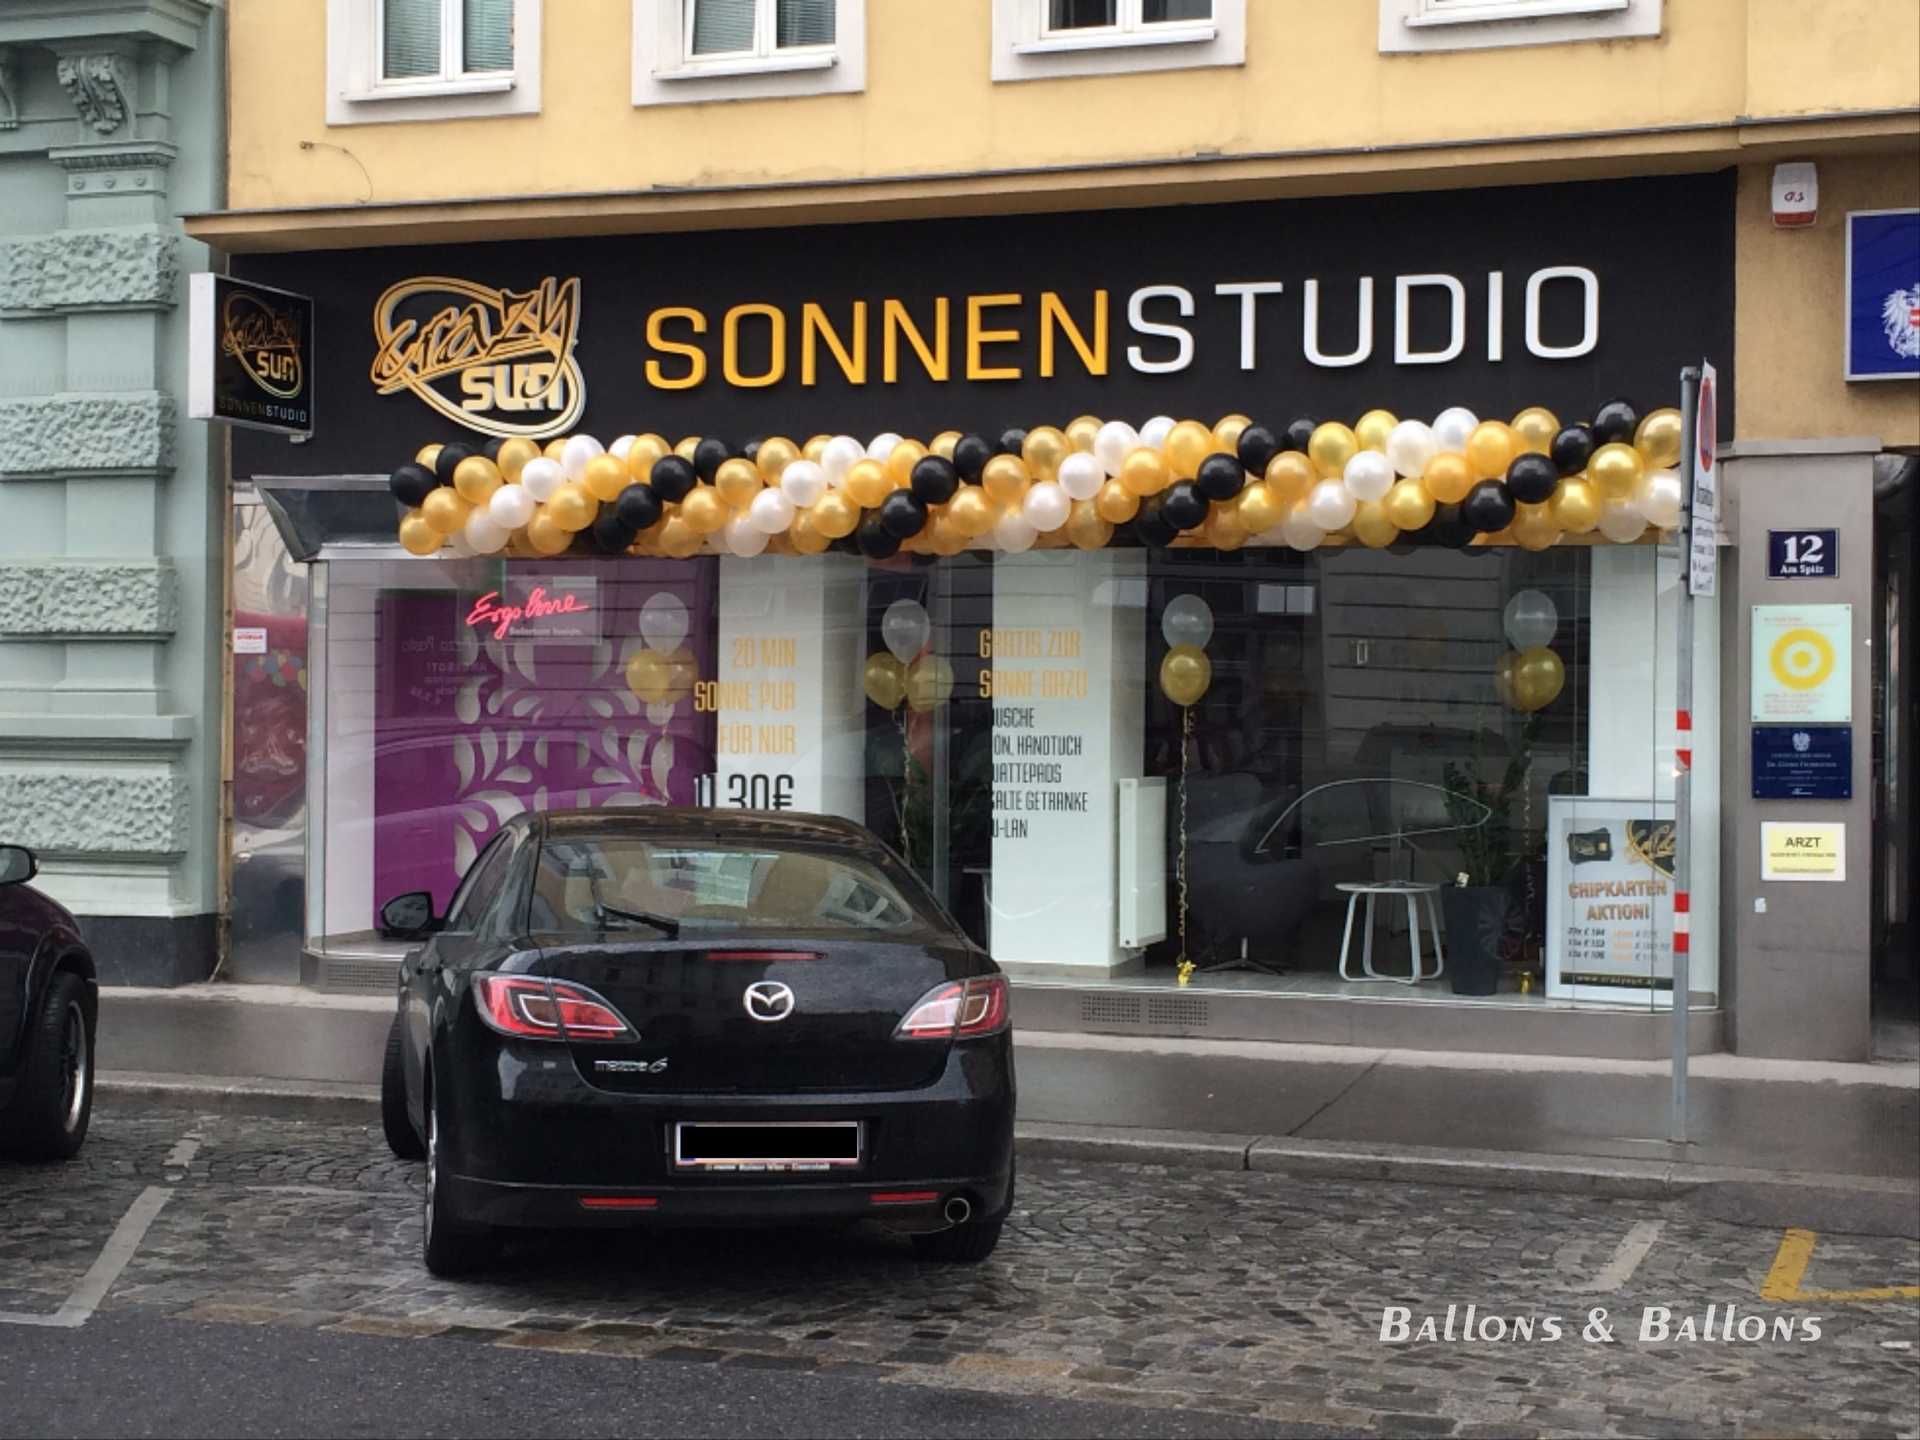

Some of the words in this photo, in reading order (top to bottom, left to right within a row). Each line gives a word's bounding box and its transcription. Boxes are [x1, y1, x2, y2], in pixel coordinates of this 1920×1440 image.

[644, 265, 1601, 390] SONNENSTUDIO
[1783, 535, 1824, 564] 12
[1780, 565, 1798, 574] Am
[734, 637, 755, 668] 20
[761, 638, 797, 668] MIN
[979, 629, 1041, 658] GRATIS
[1047, 629, 1081, 658] ZUR
[694, 681, 752, 712] SONNE
[759, 681, 797, 712] PUR
[979, 670, 1032, 698] SONNE
[1040, 670, 1088, 699] DAZU
[991, 707, 1035, 728] USCHE
[758, 724, 797, 755] NUR
[1017, 735, 1082, 757] HANDTUCH
[1784, 837, 1822, 848] ARZT
[1568, 880, 1667, 898] CHIPKARTEN
